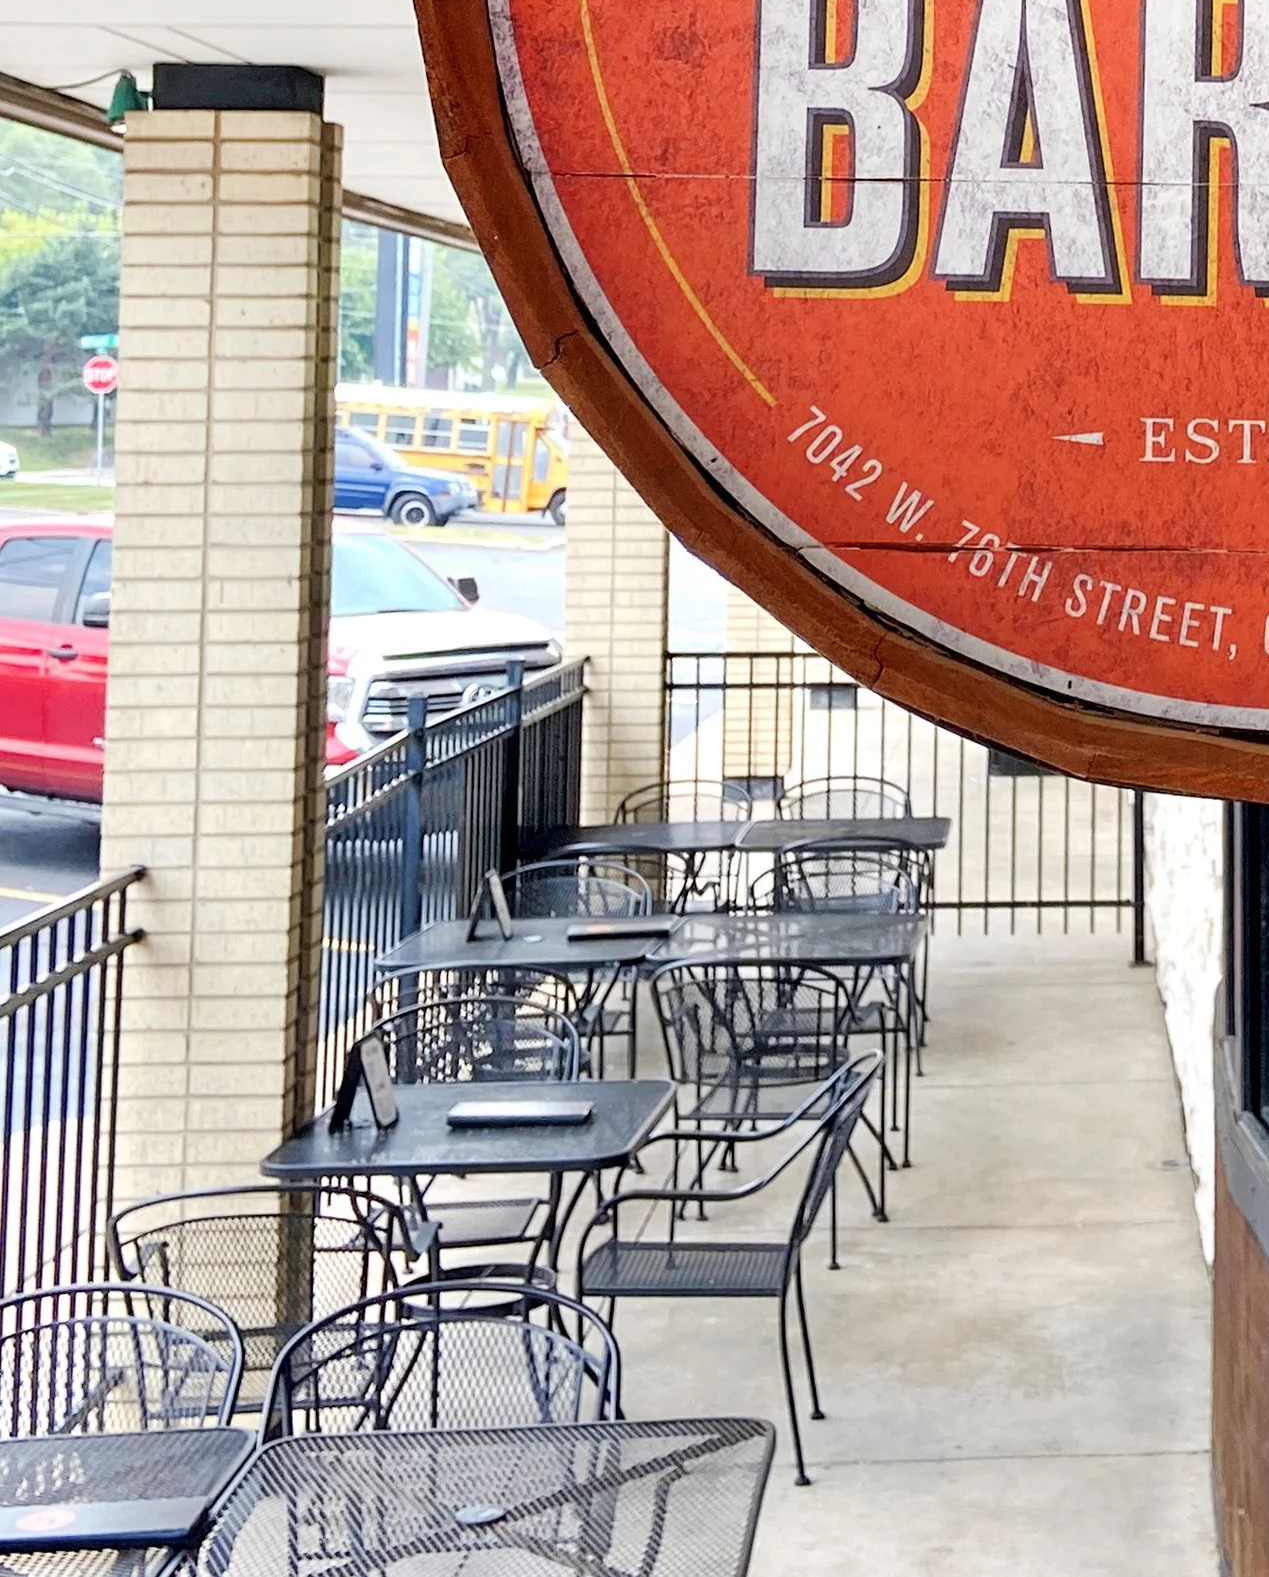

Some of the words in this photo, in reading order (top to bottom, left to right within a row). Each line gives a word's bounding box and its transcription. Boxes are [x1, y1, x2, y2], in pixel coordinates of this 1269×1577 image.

[787, 405, 884, 502] 7042
[885, 481, 934, 542] W.
[948, 520, 1053, 602] 76TH
[1065, 573, 1239, 661] STREET,
